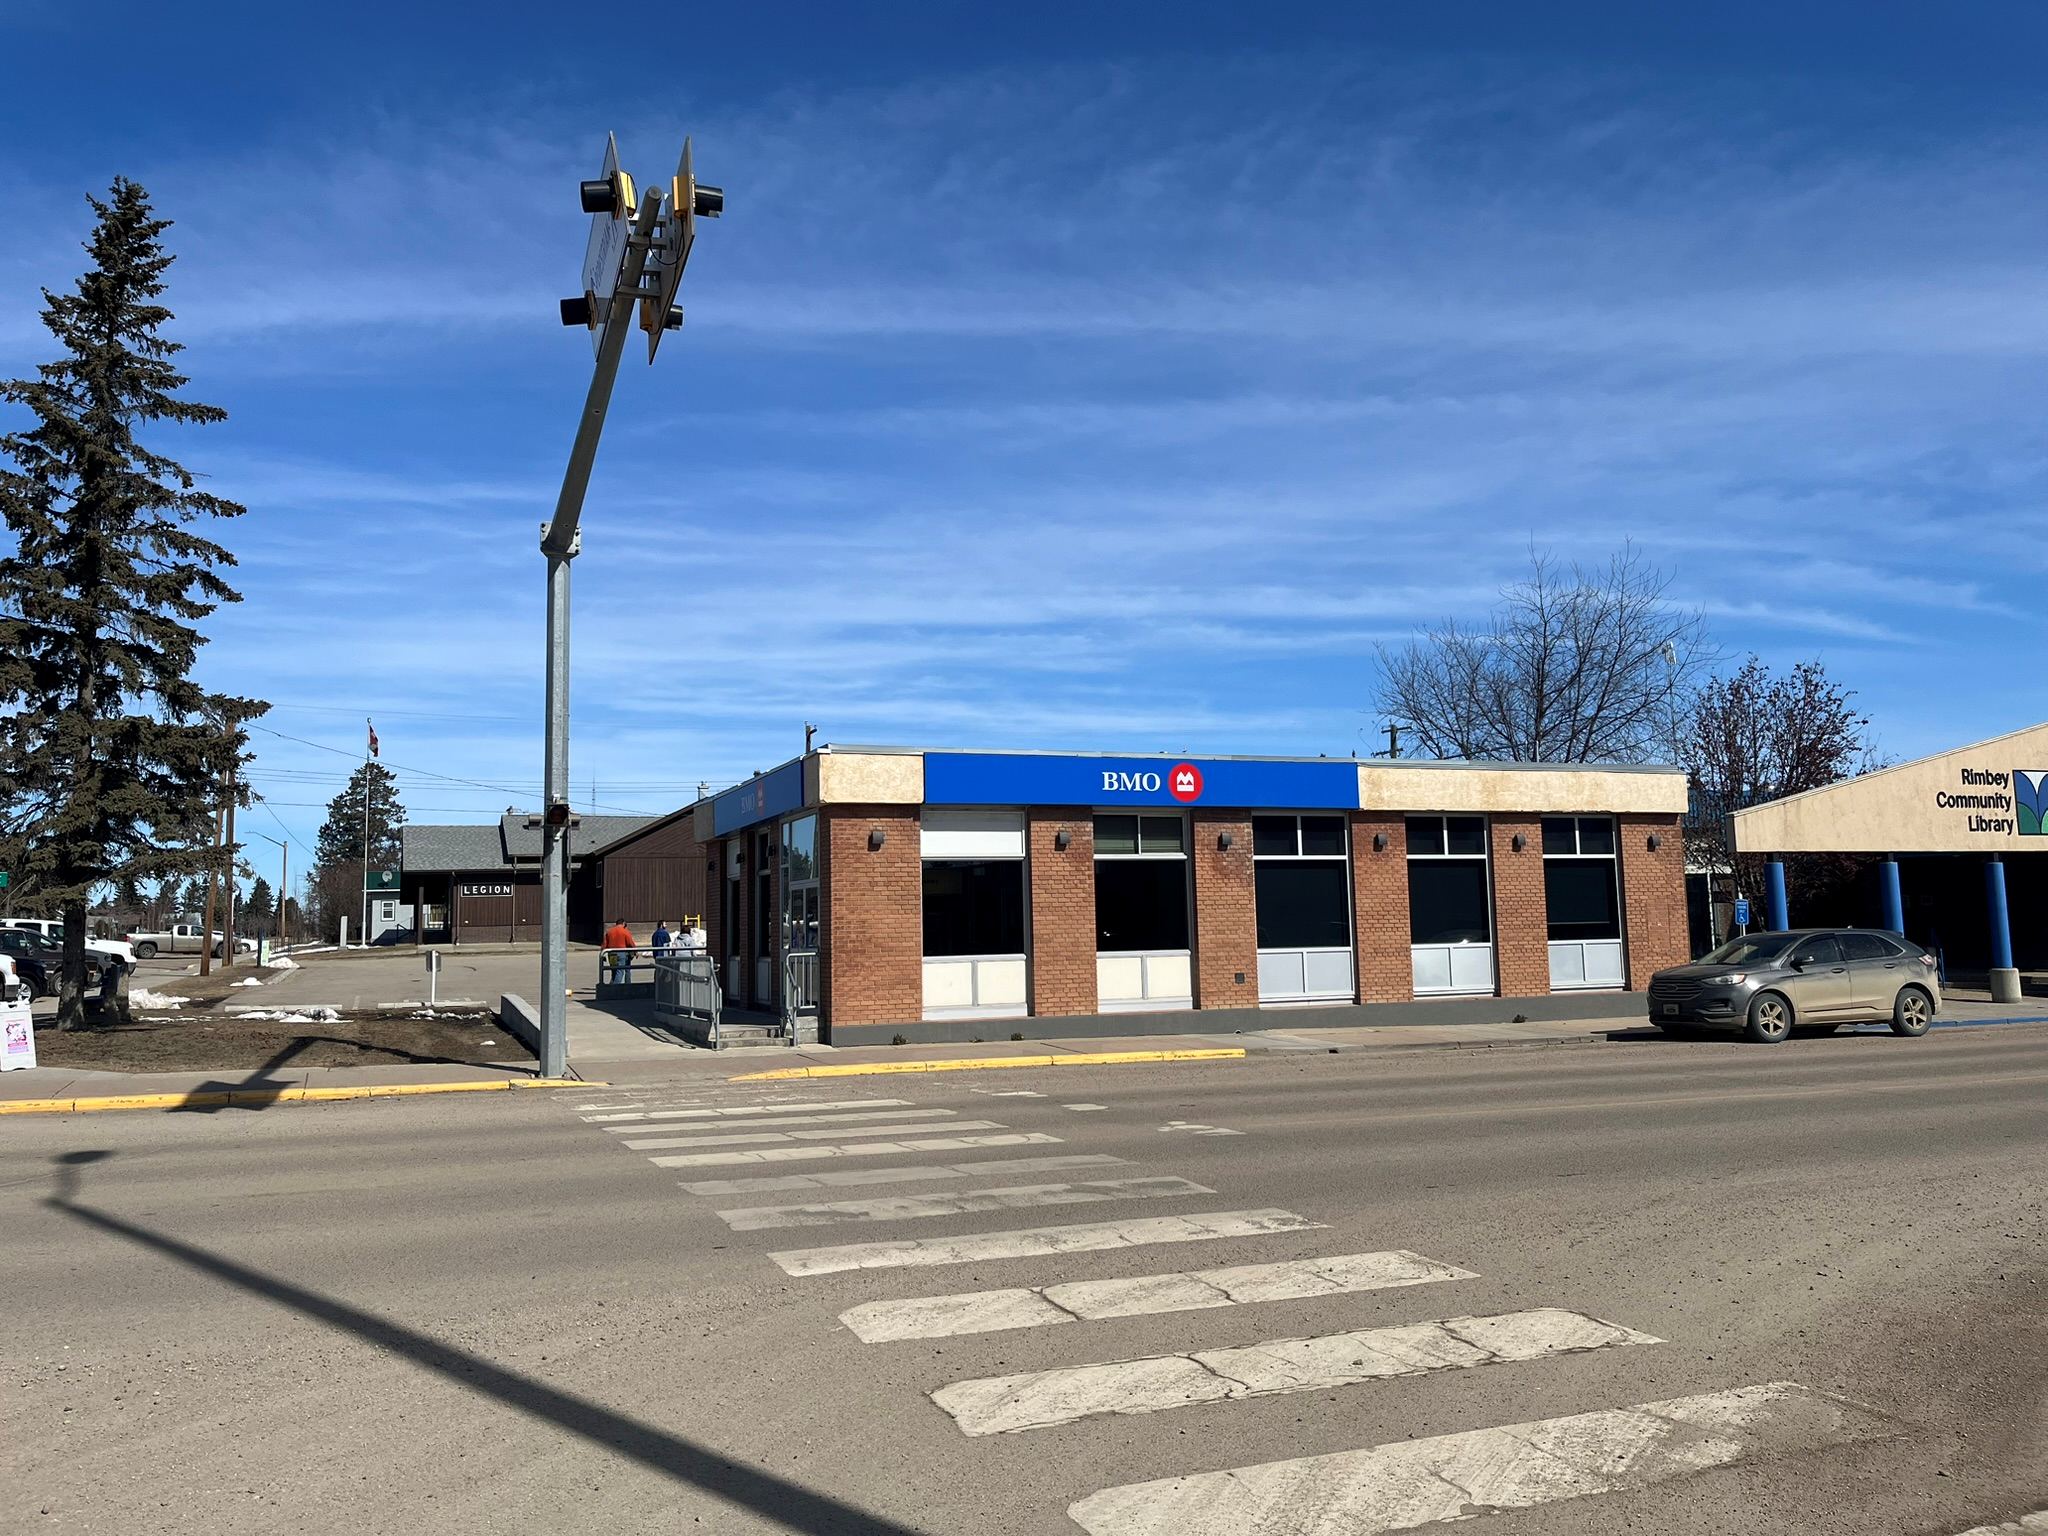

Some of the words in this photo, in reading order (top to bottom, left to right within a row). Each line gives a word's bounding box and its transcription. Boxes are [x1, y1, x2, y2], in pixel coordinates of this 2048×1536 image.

[1102, 772, 1161, 791] BMO
[1961, 768, 2009, 789] Rimbey
[1936, 791, 2011, 812] Community
[1968, 815, 2014, 836] Library
[464, 885, 510, 894] LEGION
